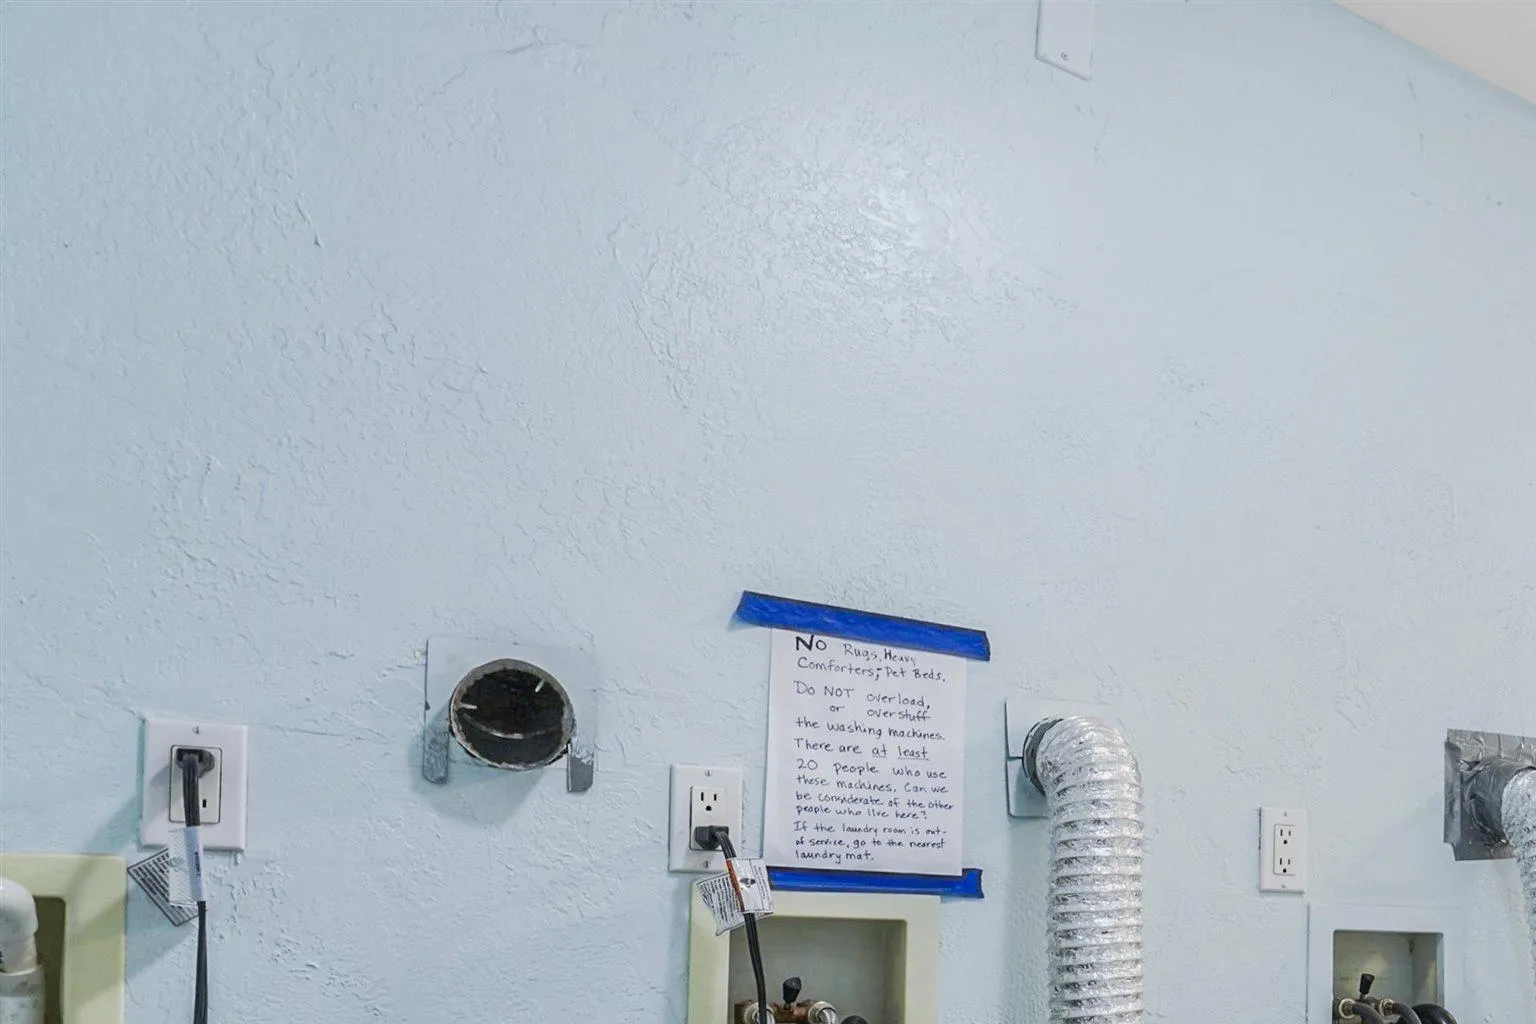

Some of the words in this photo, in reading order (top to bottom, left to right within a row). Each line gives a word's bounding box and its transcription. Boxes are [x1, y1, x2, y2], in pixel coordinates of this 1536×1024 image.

[884, 648, 916, 666] Heavy
[886, 666, 906, 678] Pet
[794, 680, 815, 696] Do
[824, 686, 854, 697] NOT
[795, 716, 820, 728] the
[827, 720, 882, 737] washing
[794, 738, 833, 751] There
[839, 744, 862, 754] are
[872, 744, 887, 756] at
[898, 746, 928, 759] least
[797, 758, 818, 771] 20
[833, 762, 879, 776] people
[892, 766, 921, 777] who
[926, 770, 947, 779] use
[796, 775, 829, 786] these
[904, 782, 927, 793] Can
[931, 785, 949, 793] we
[795, 790, 812, 801] be
[818, 793, 883, 805] considerate
[888, 797, 899, 807] of
[907, 799, 925, 809] the
[928, 801, 954, 810] other
[796, 803, 831, 815] people
[835, 807, 862, 816] who
[868, 809, 889, 817] live
[895, 810, 927, 820] here?
[793, 820, 808, 833] If
[814, 823, 835, 833] the
[842, 823, 878, 835] laundry
[910, 827, 920, 835] is
[795, 837, 804, 845] of
[853, 840, 866, 849] go
[888, 839, 904, 847] the
[910, 839, 945, 848] nearest
